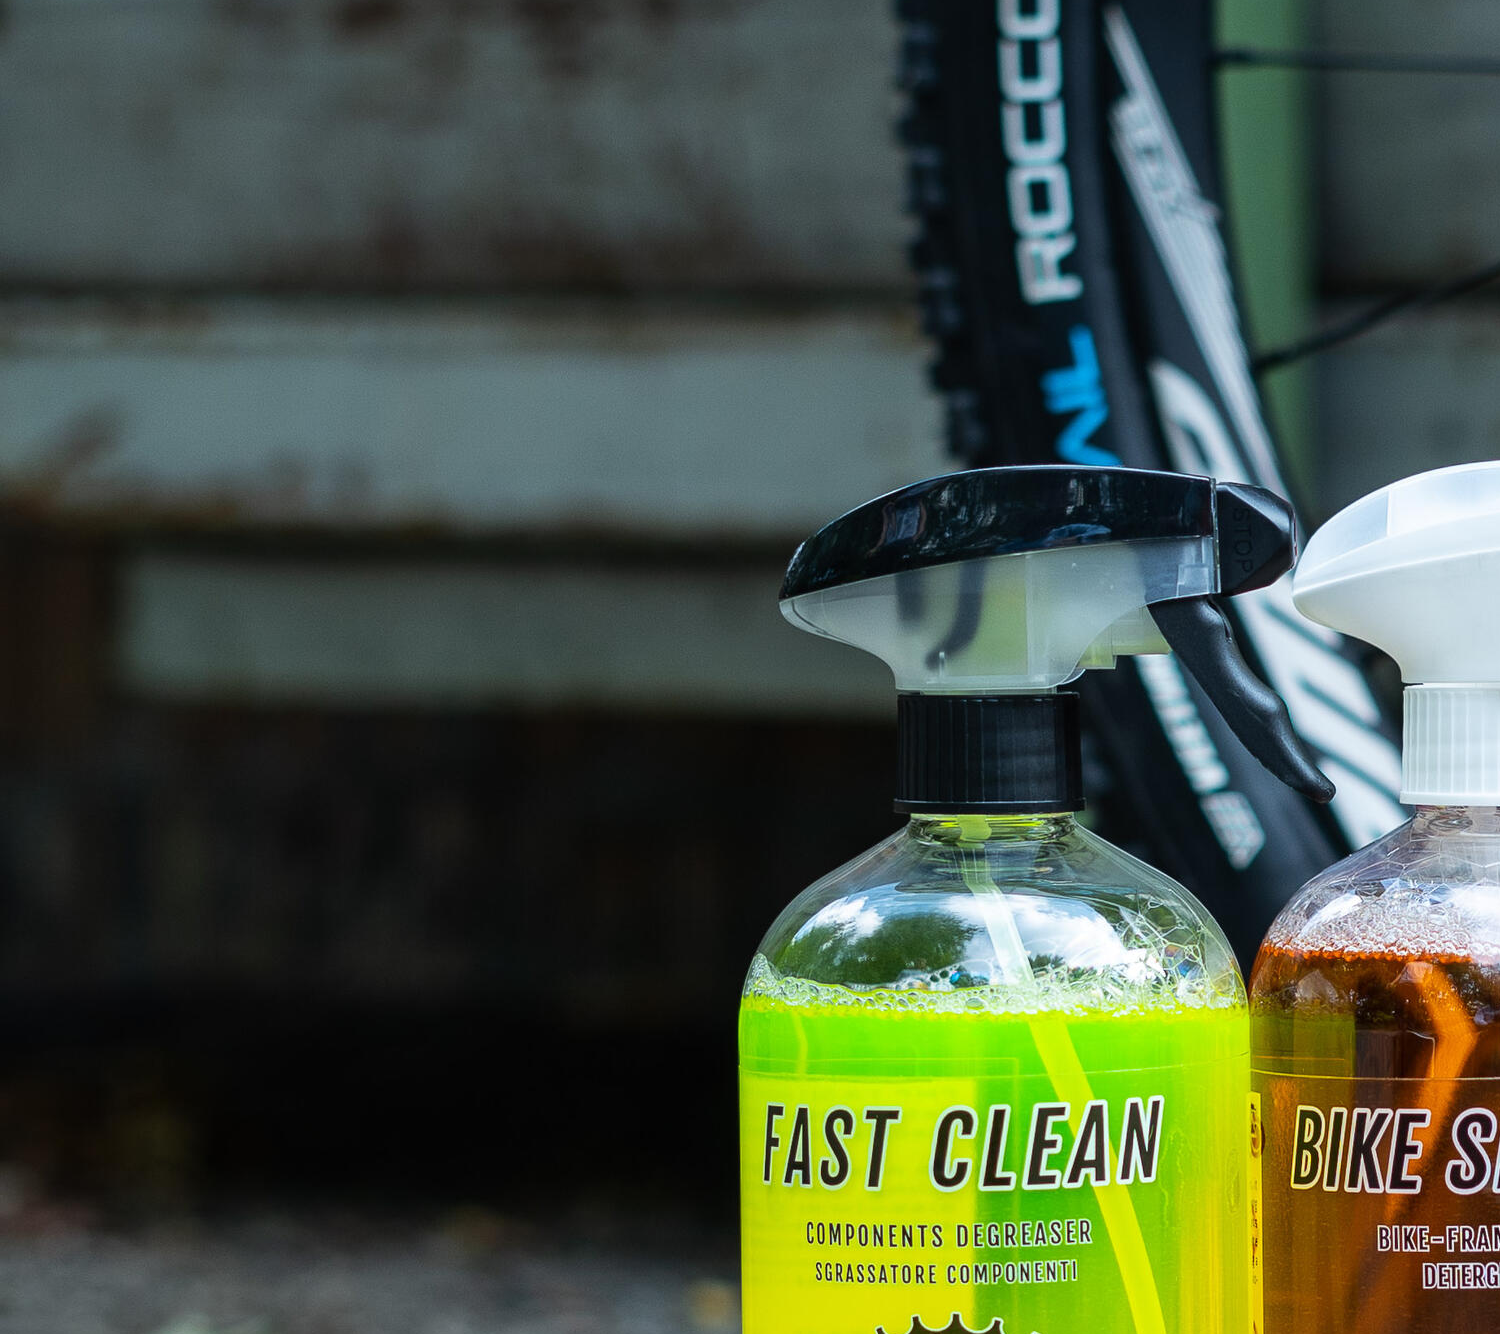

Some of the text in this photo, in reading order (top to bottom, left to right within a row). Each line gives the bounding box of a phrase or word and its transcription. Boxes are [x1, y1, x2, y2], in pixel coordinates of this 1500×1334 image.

[1232, 507, 1254, 574] STOP
[763, 1095, 1165, 1191] FAST CLEAN
[1291, 1104, 1431, 1195] BIKE
[806, 1218, 1093, 1248] COMPONENTS DEGREASER
[814, 1259, 1079, 1284] SGRASSATORE COMPONENTI
